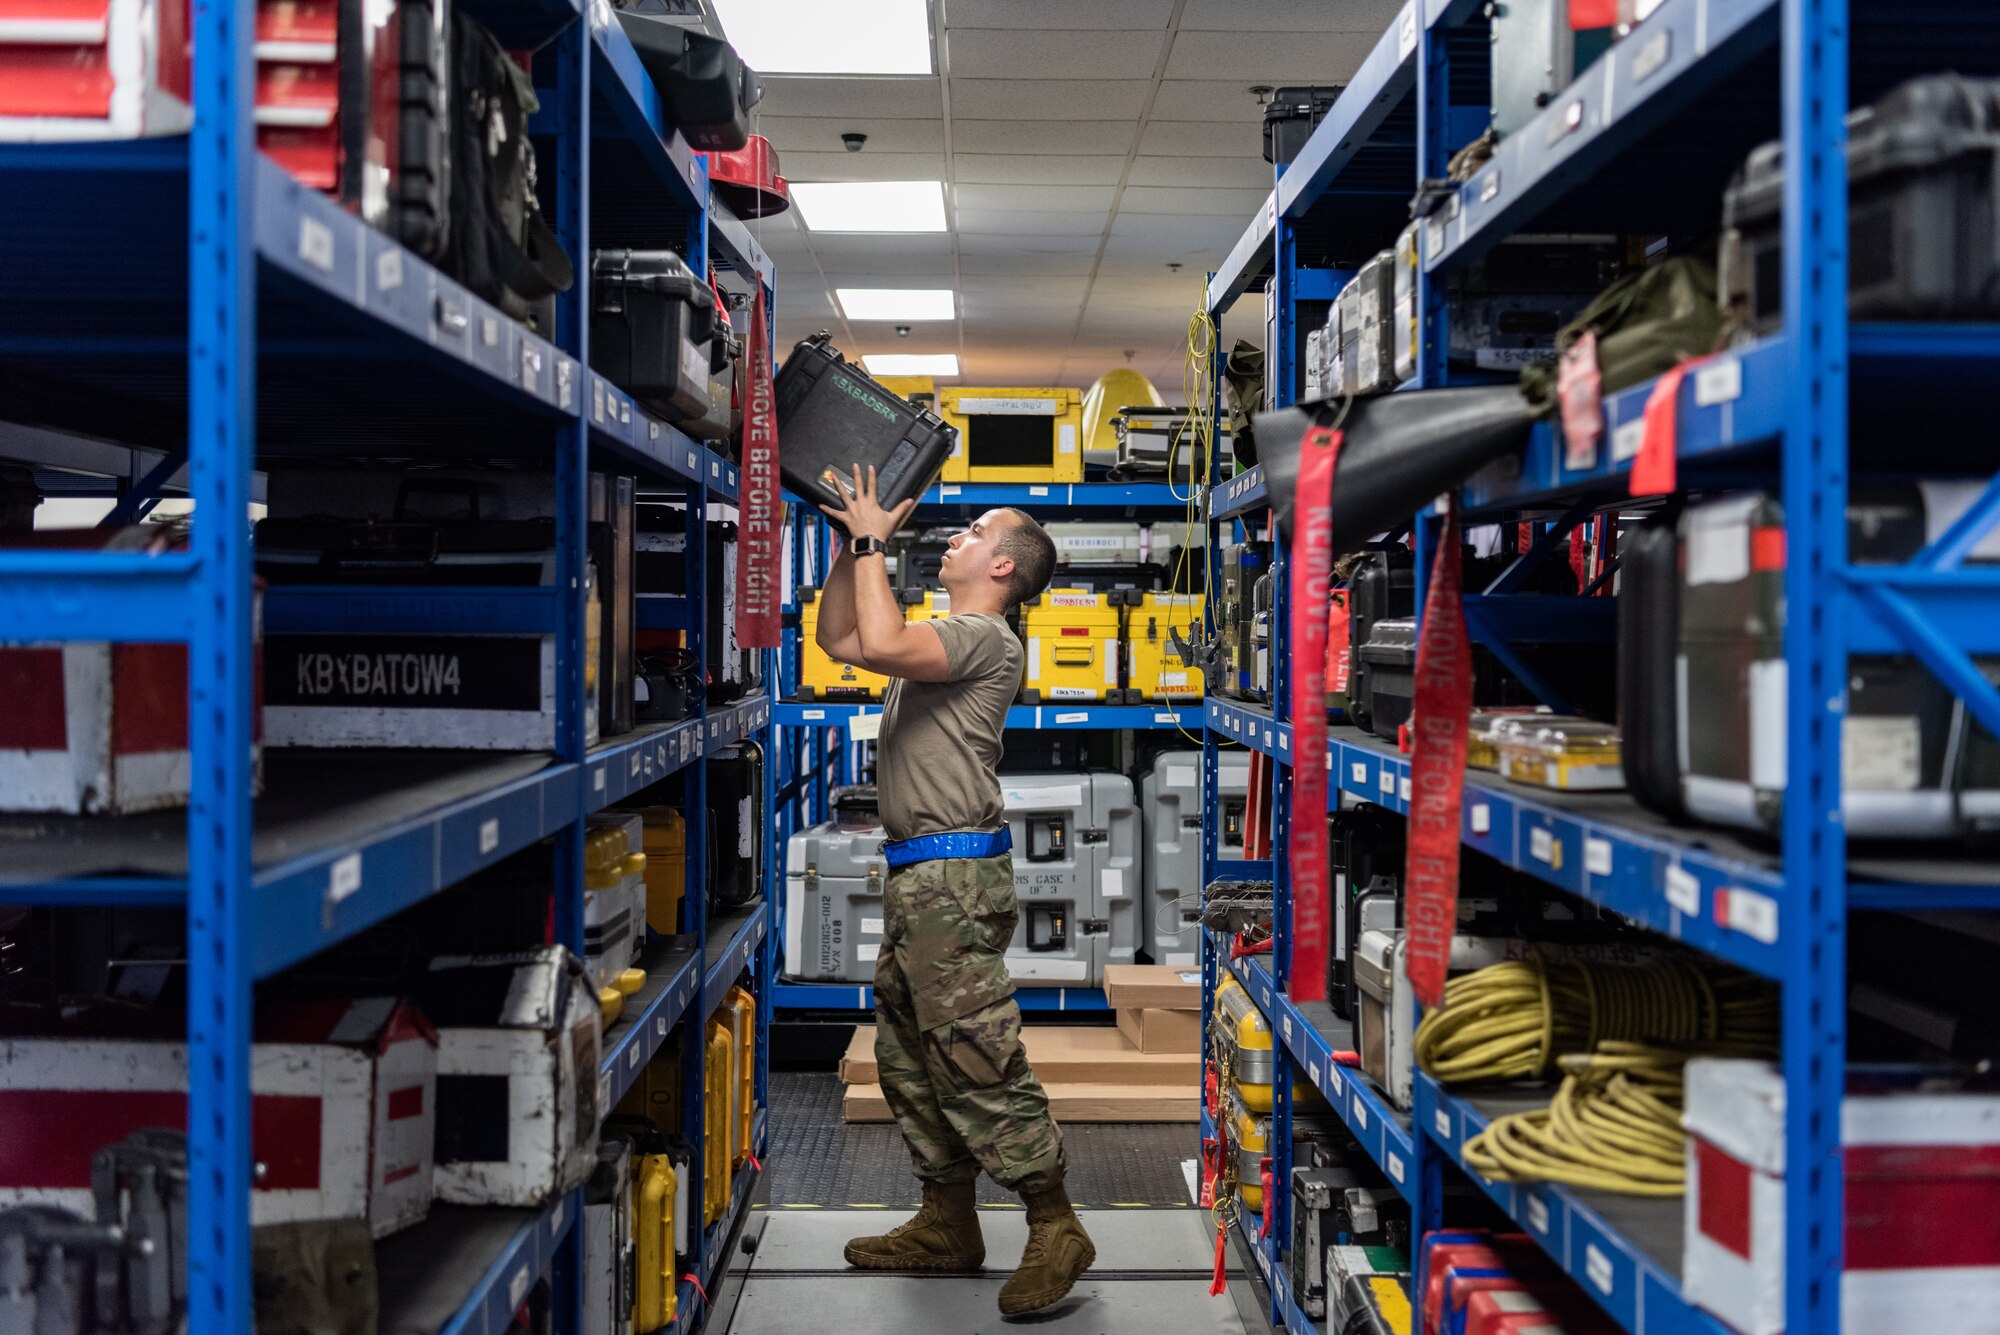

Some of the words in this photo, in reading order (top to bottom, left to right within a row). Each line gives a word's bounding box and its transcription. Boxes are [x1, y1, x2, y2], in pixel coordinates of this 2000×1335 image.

[751, 349, 770, 441] REMOVE
[748, 448, 771, 533] BEFORE
[746, 540, 771, 618] FLIGHT
[1420, 716, 1456, 833] BEFORE
[1029, 885, 1043, 895] OF
[1050, 885, 1057, 894] 3
[1036, 874, 1063, 884] CASE
[1297, 831, 1320, 951] FLIGHT
[1414, 855, 1446, 965] FLIGHT
[833, 920, 842, 943] 008
